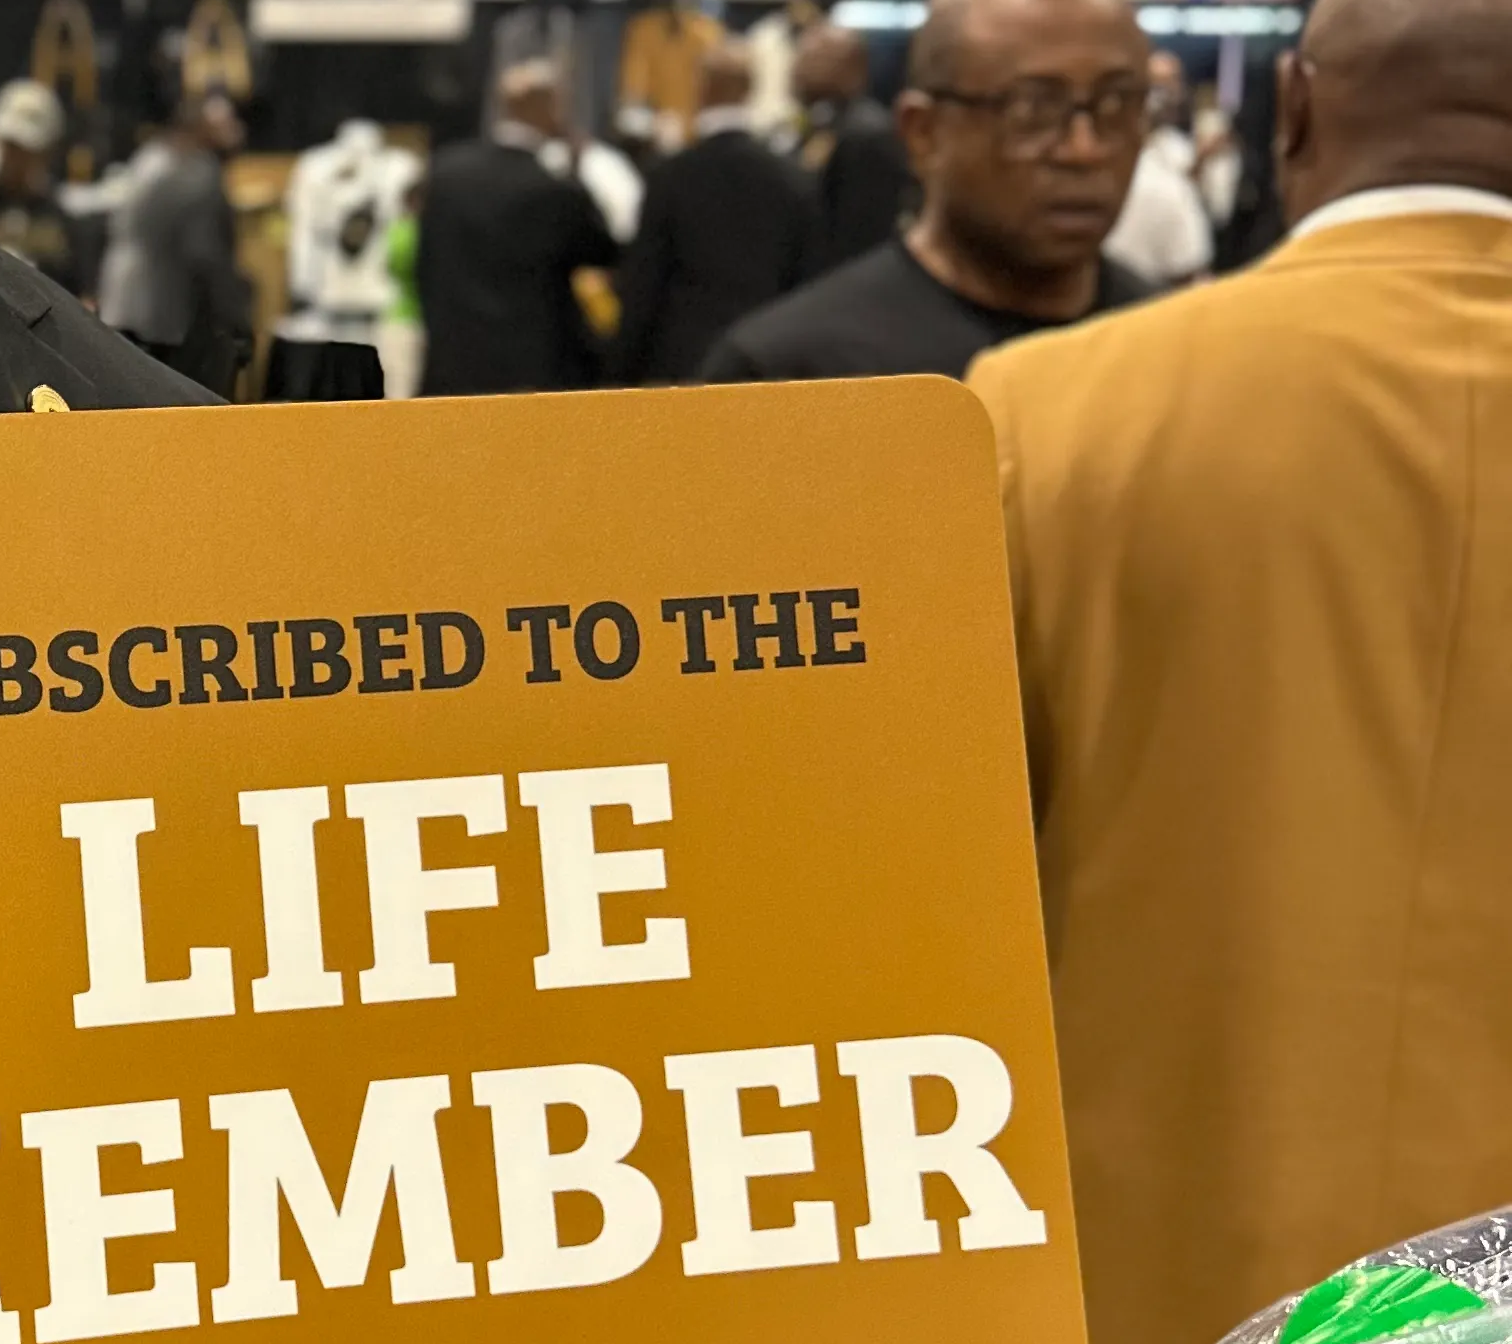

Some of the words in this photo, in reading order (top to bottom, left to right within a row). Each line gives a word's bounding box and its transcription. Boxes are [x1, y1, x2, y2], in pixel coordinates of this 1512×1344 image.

[506, 600, 641, 685] TO
[660, 587, 867, 675] THE
[60, 763, 691, 1029] LIFE
